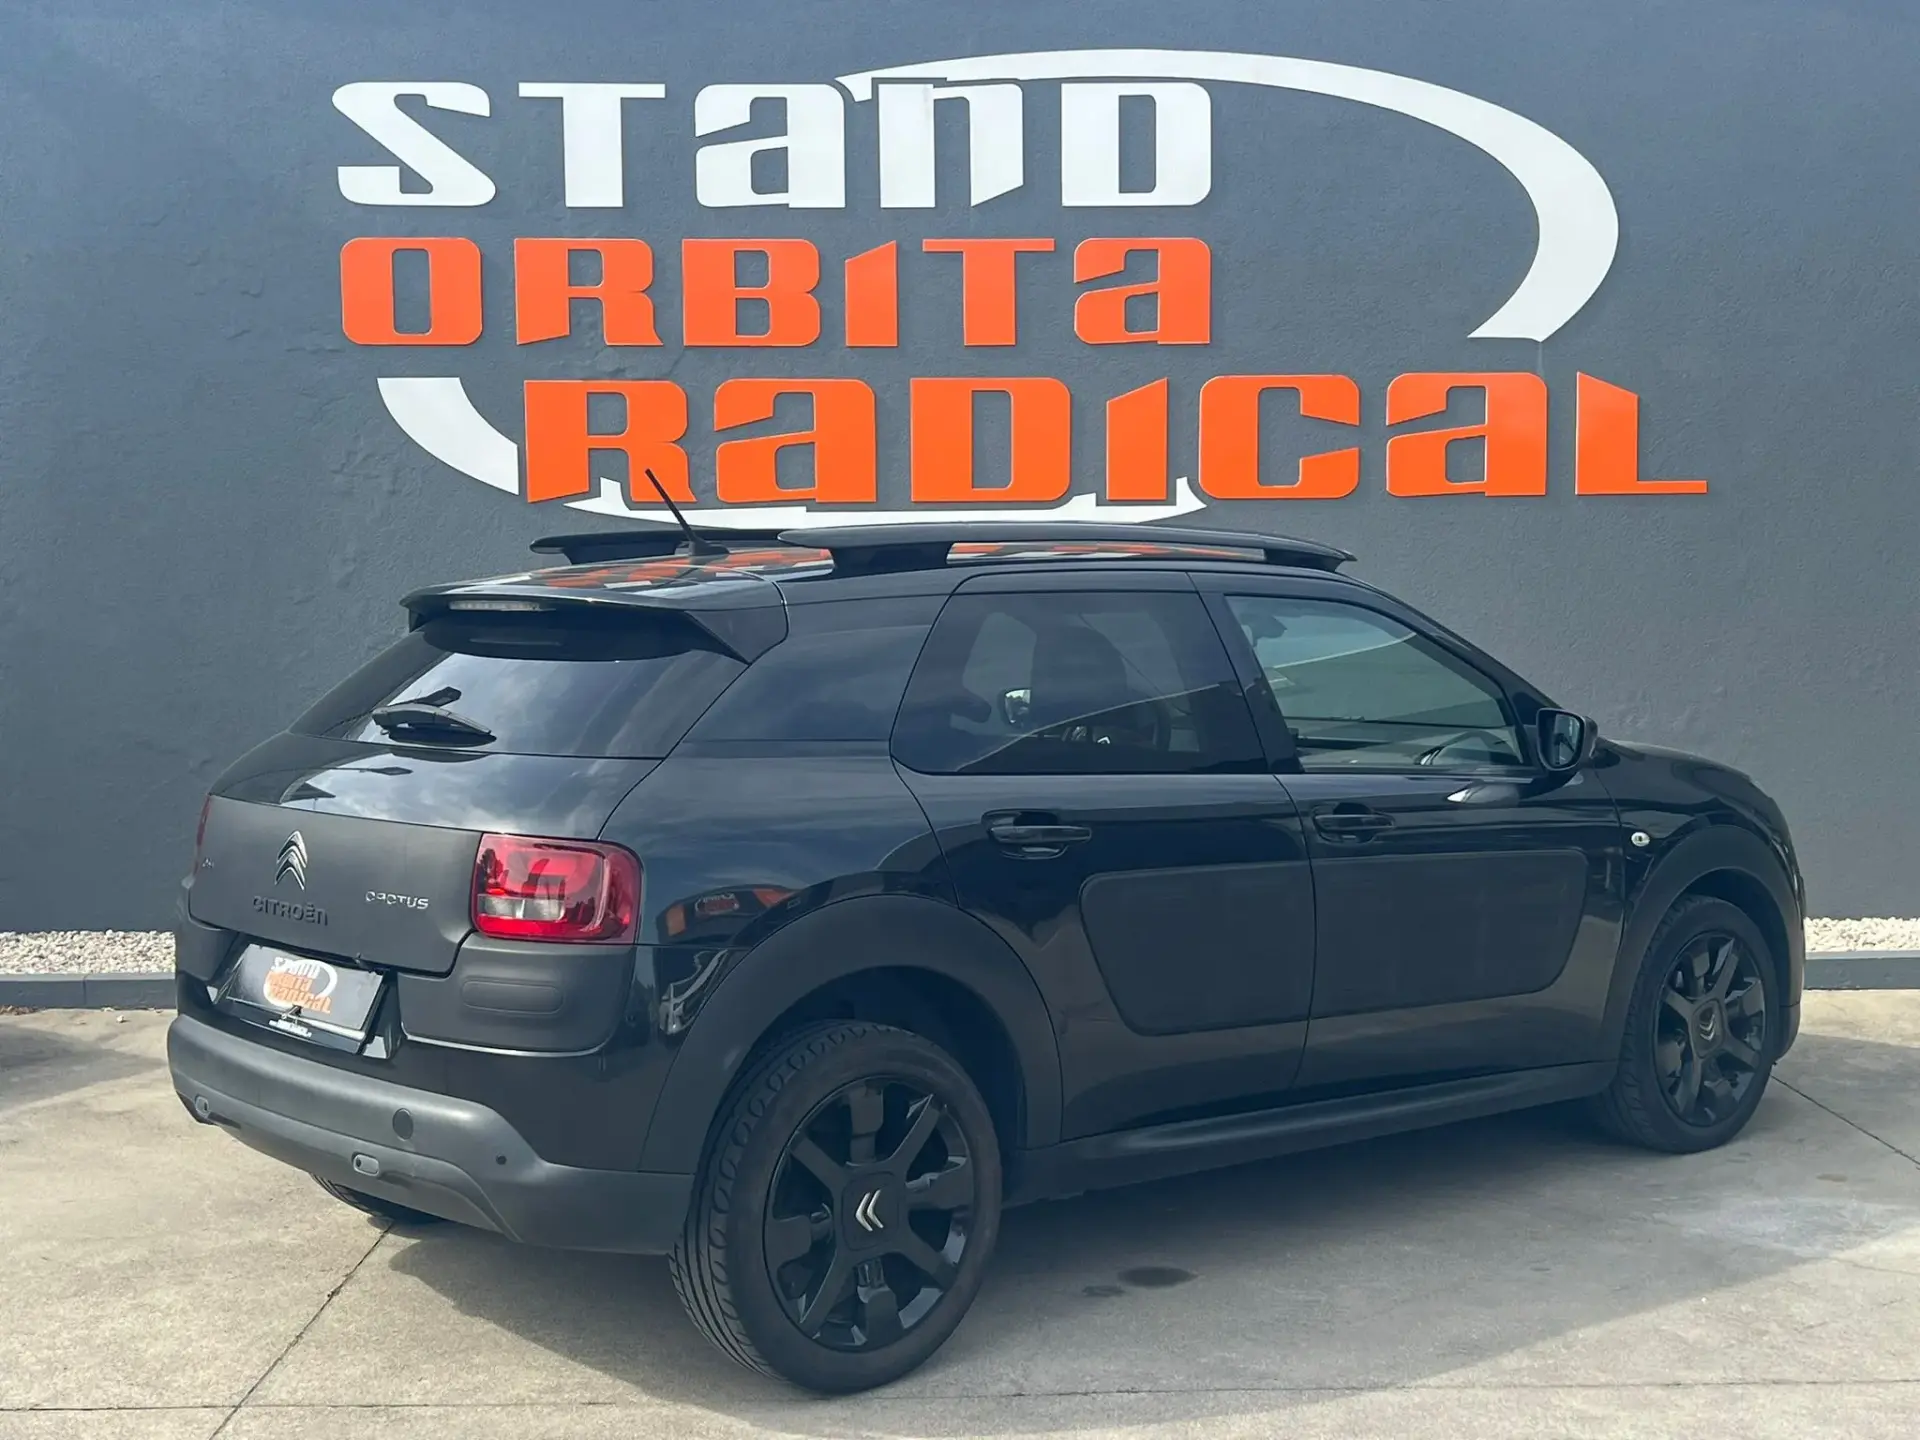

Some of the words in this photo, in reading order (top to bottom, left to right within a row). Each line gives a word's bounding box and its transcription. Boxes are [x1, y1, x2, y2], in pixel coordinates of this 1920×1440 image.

[332, 82, 1211, 207] STAND
[341, 238, 1211, 346] ORBITA
[524, 373, 1707, 503] RADICAL
